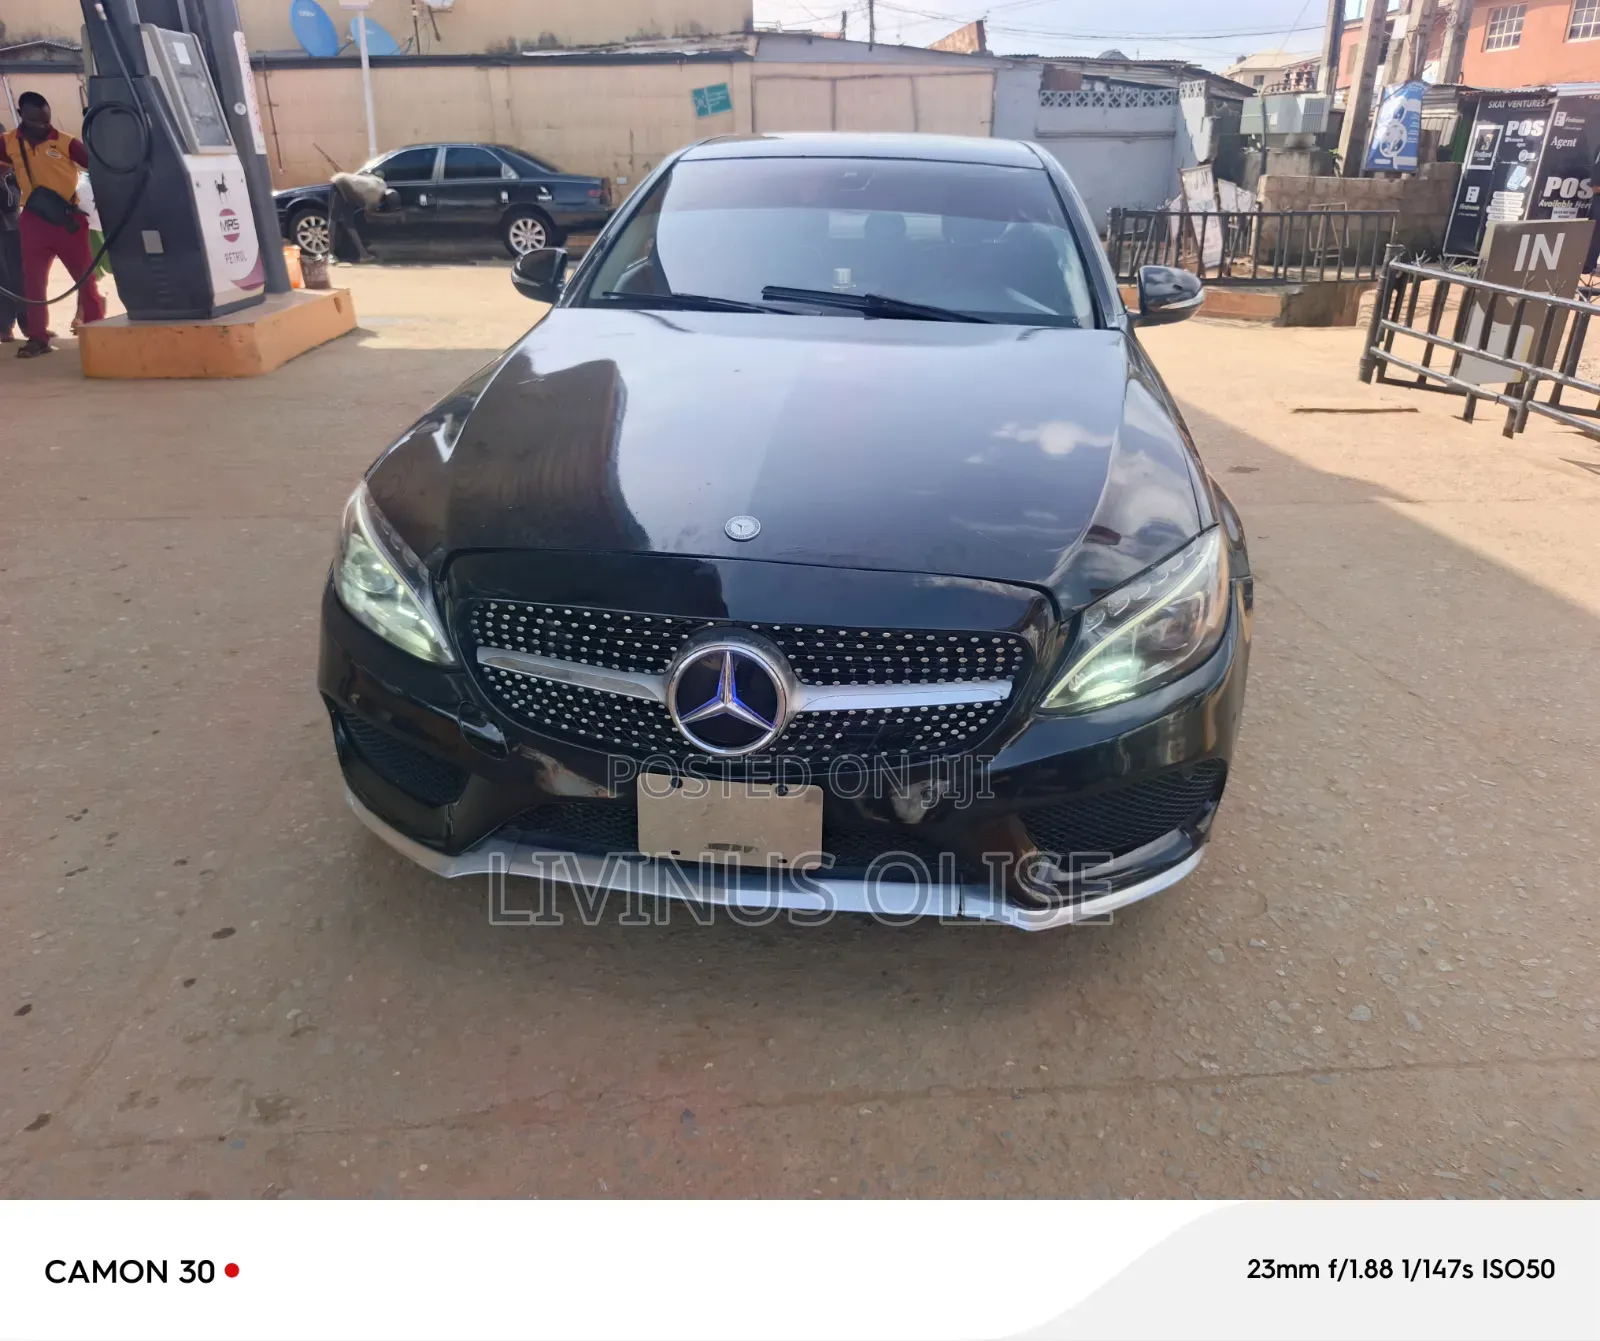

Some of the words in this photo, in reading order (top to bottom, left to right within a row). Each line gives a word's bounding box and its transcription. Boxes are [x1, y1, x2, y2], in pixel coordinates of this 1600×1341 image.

[1488, 100, 1505, 109] SKAT
[1507, 99, 1546, 108] VENTURES
[1505, 120, 1545, 137] POS
[1550, 136, 1577, 150] Agent
[1543, 176, 1594, 199] POS
[1538, 199, 1573, 209] Available
[219, 218, 240, 233] MRS
[224, 250, 248, 264] PETROL
[1513, 232, 1566, 272] IN
